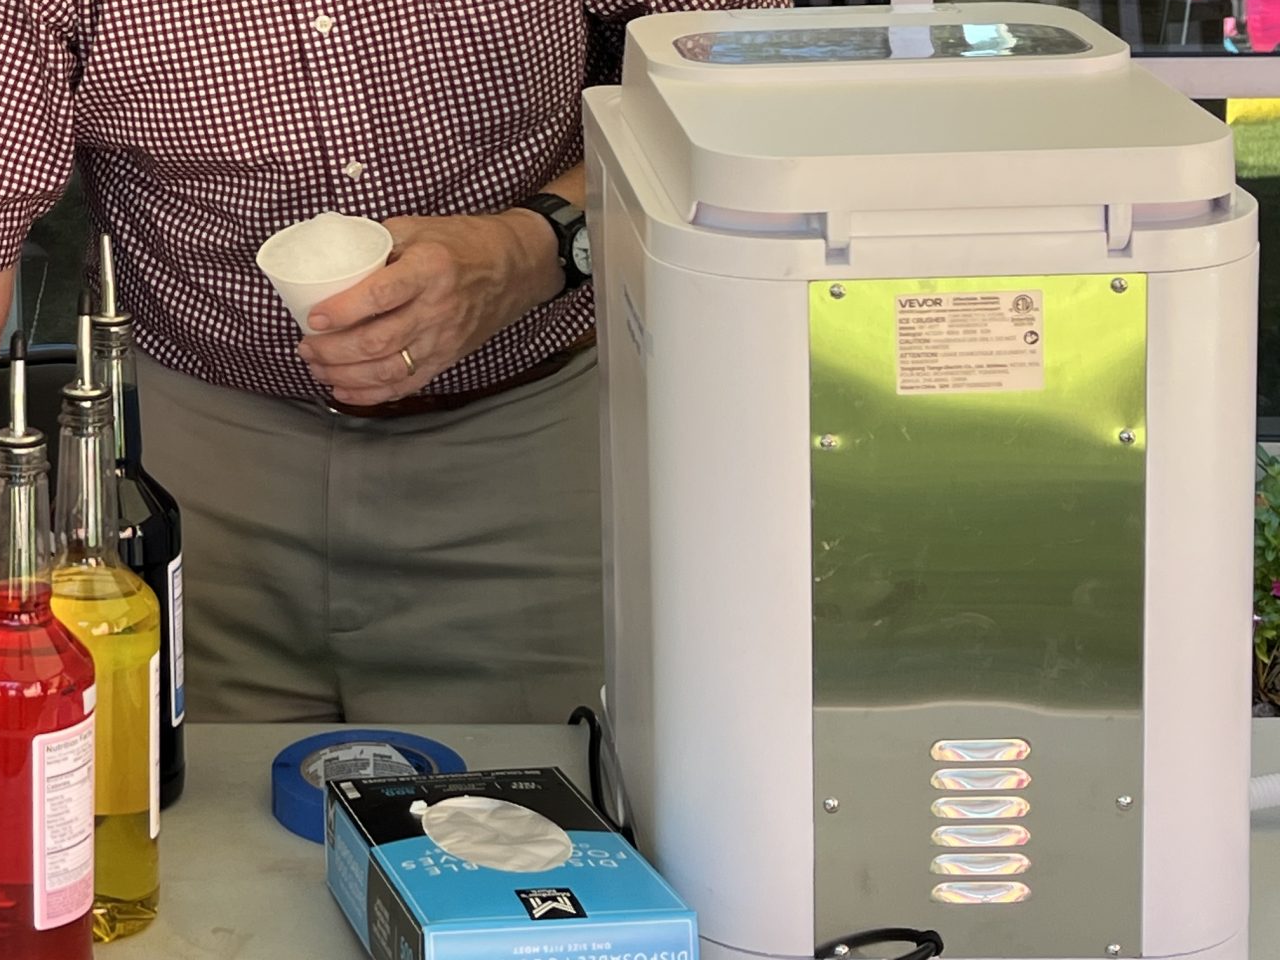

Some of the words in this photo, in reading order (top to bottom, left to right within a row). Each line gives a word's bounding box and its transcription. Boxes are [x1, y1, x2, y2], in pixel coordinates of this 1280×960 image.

[898, 297, 943, 308] VEVOR
[46, 739, 78, 753] Nutrition
[512, 945, 540, 954] MOST
[543, 944, 564, 952] FITS
[567, 942, 587, 951] SIZE
[592, 941, 612, 950] ONE
